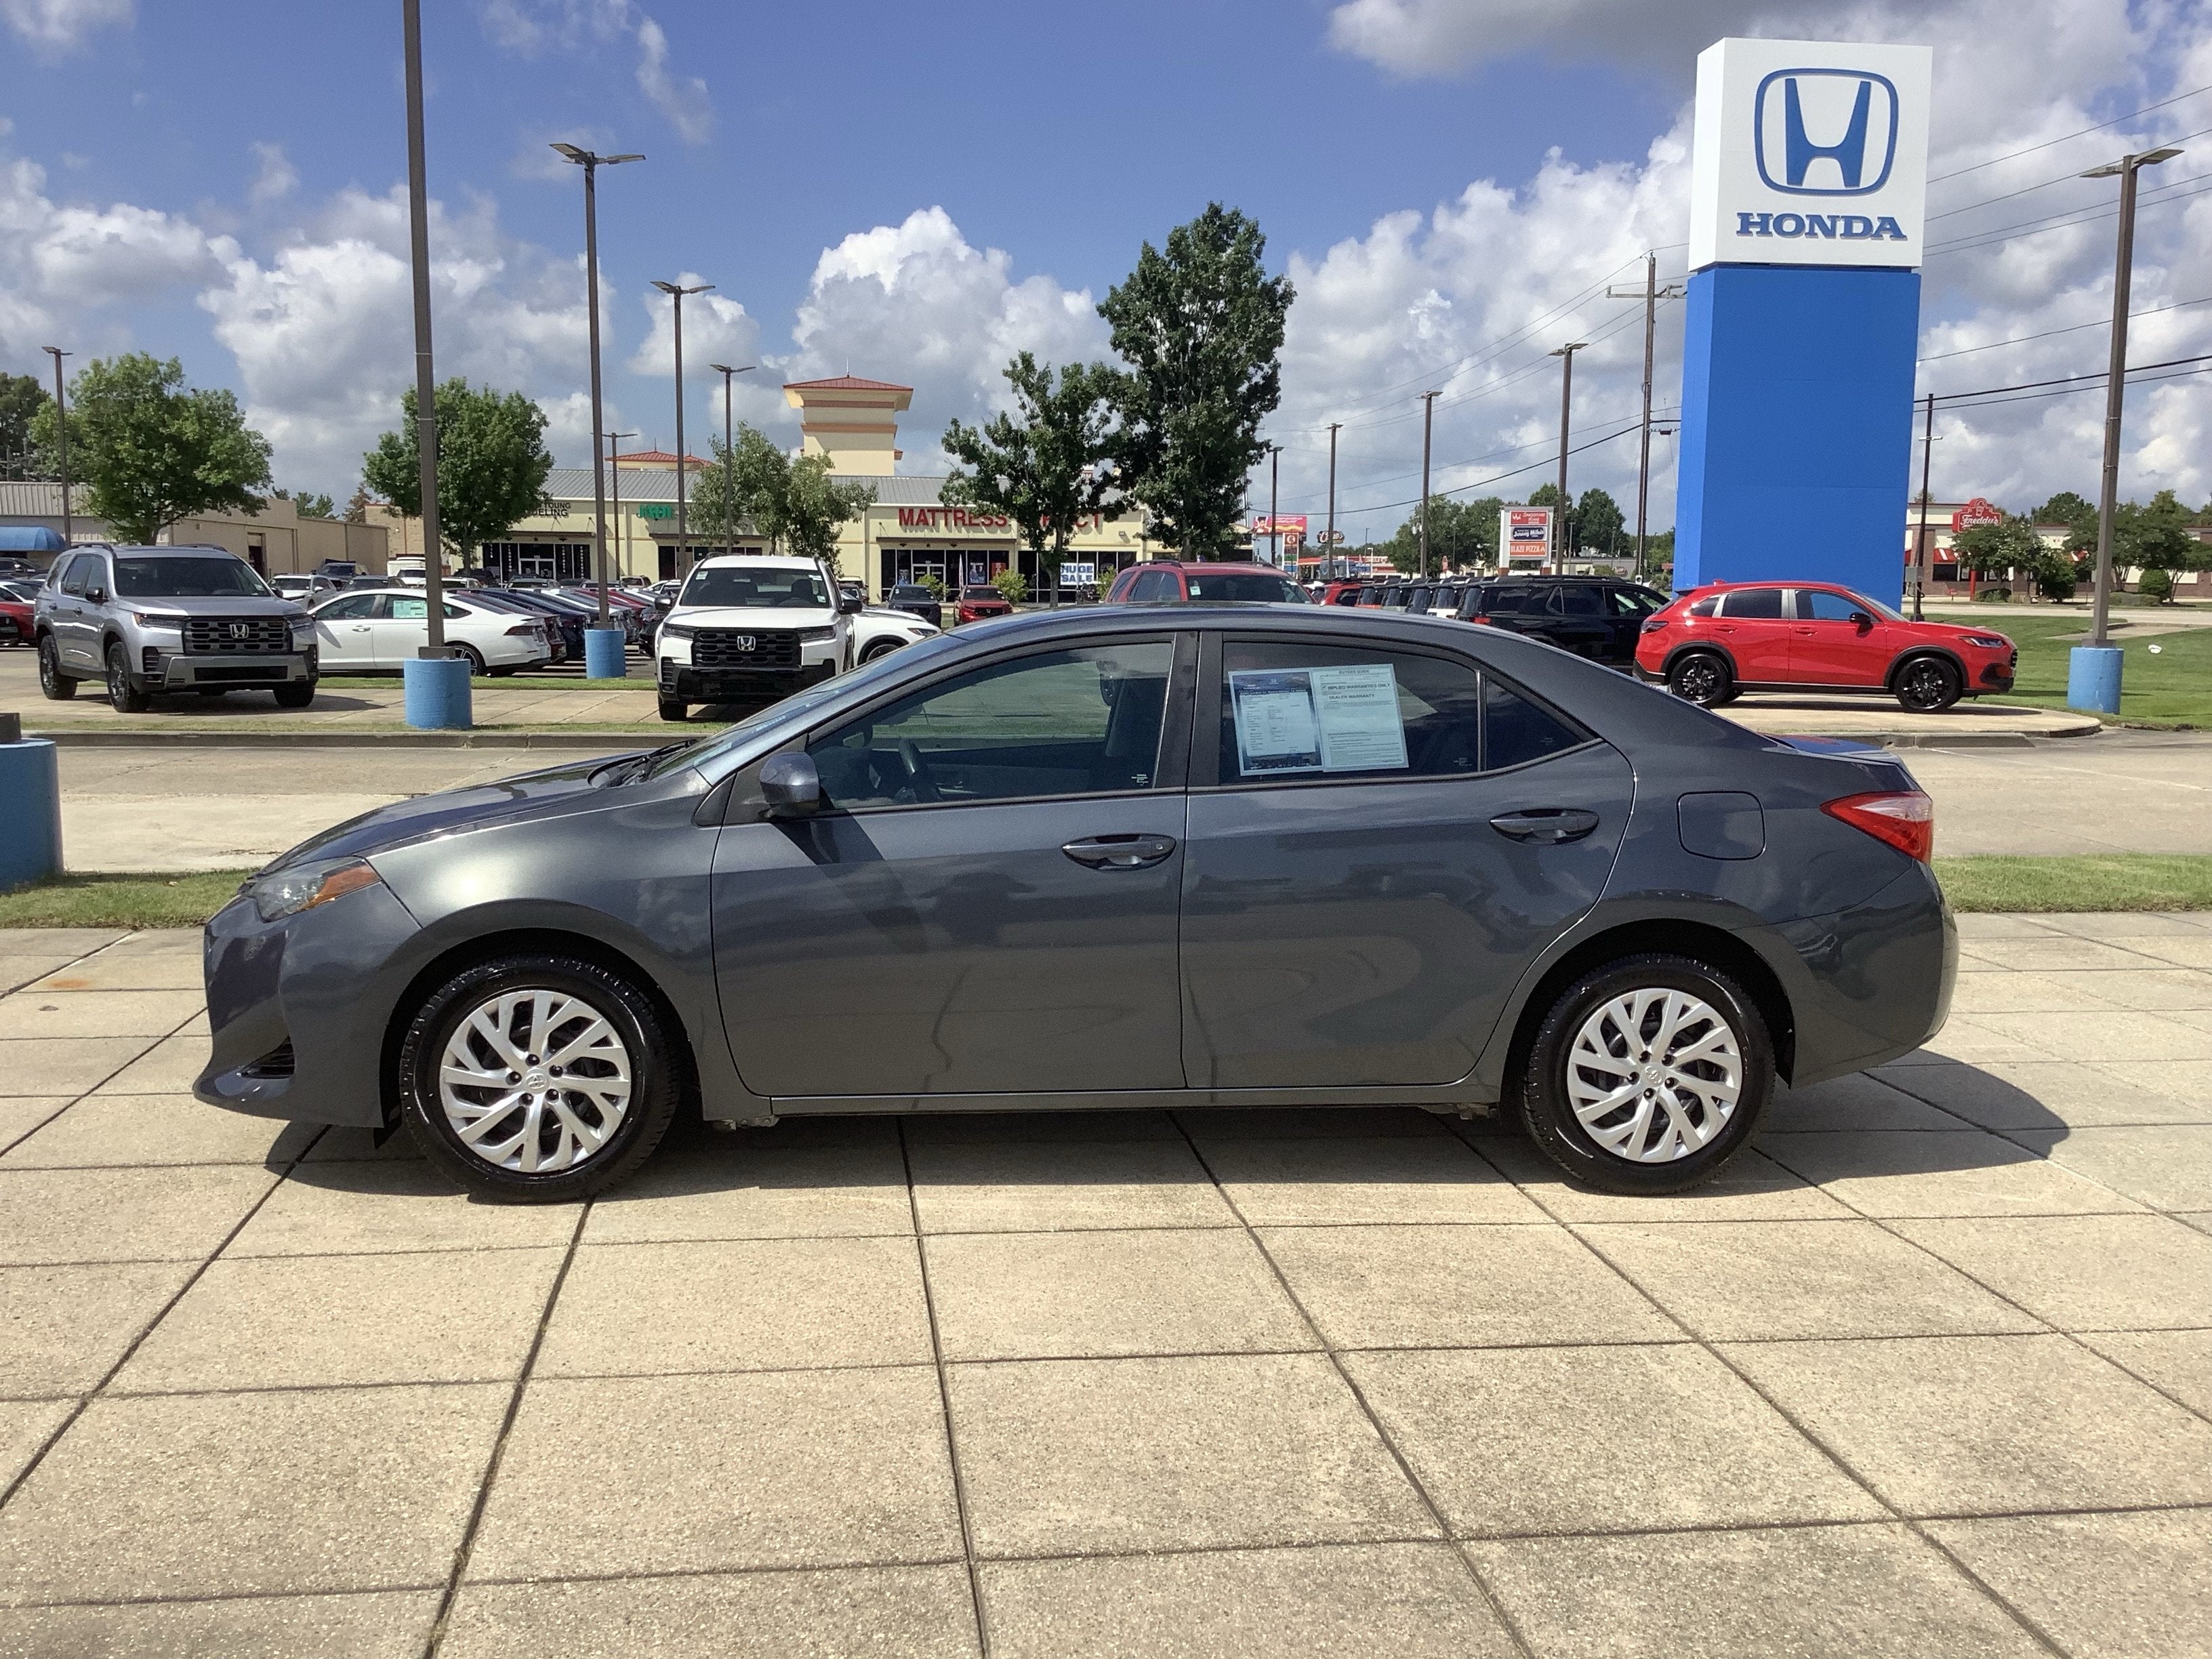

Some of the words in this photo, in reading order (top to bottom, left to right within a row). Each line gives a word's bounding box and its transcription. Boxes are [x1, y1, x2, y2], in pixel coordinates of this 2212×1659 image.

[1736, 212, 1908, 241] HONDA
[899, 508, 1008, 527] MATTRESS
[1961, 514, 1999, 526] Freddy's
[1061, 565, 1093, 573] HUGE
[1061, 574, 1092, 582] SALE
